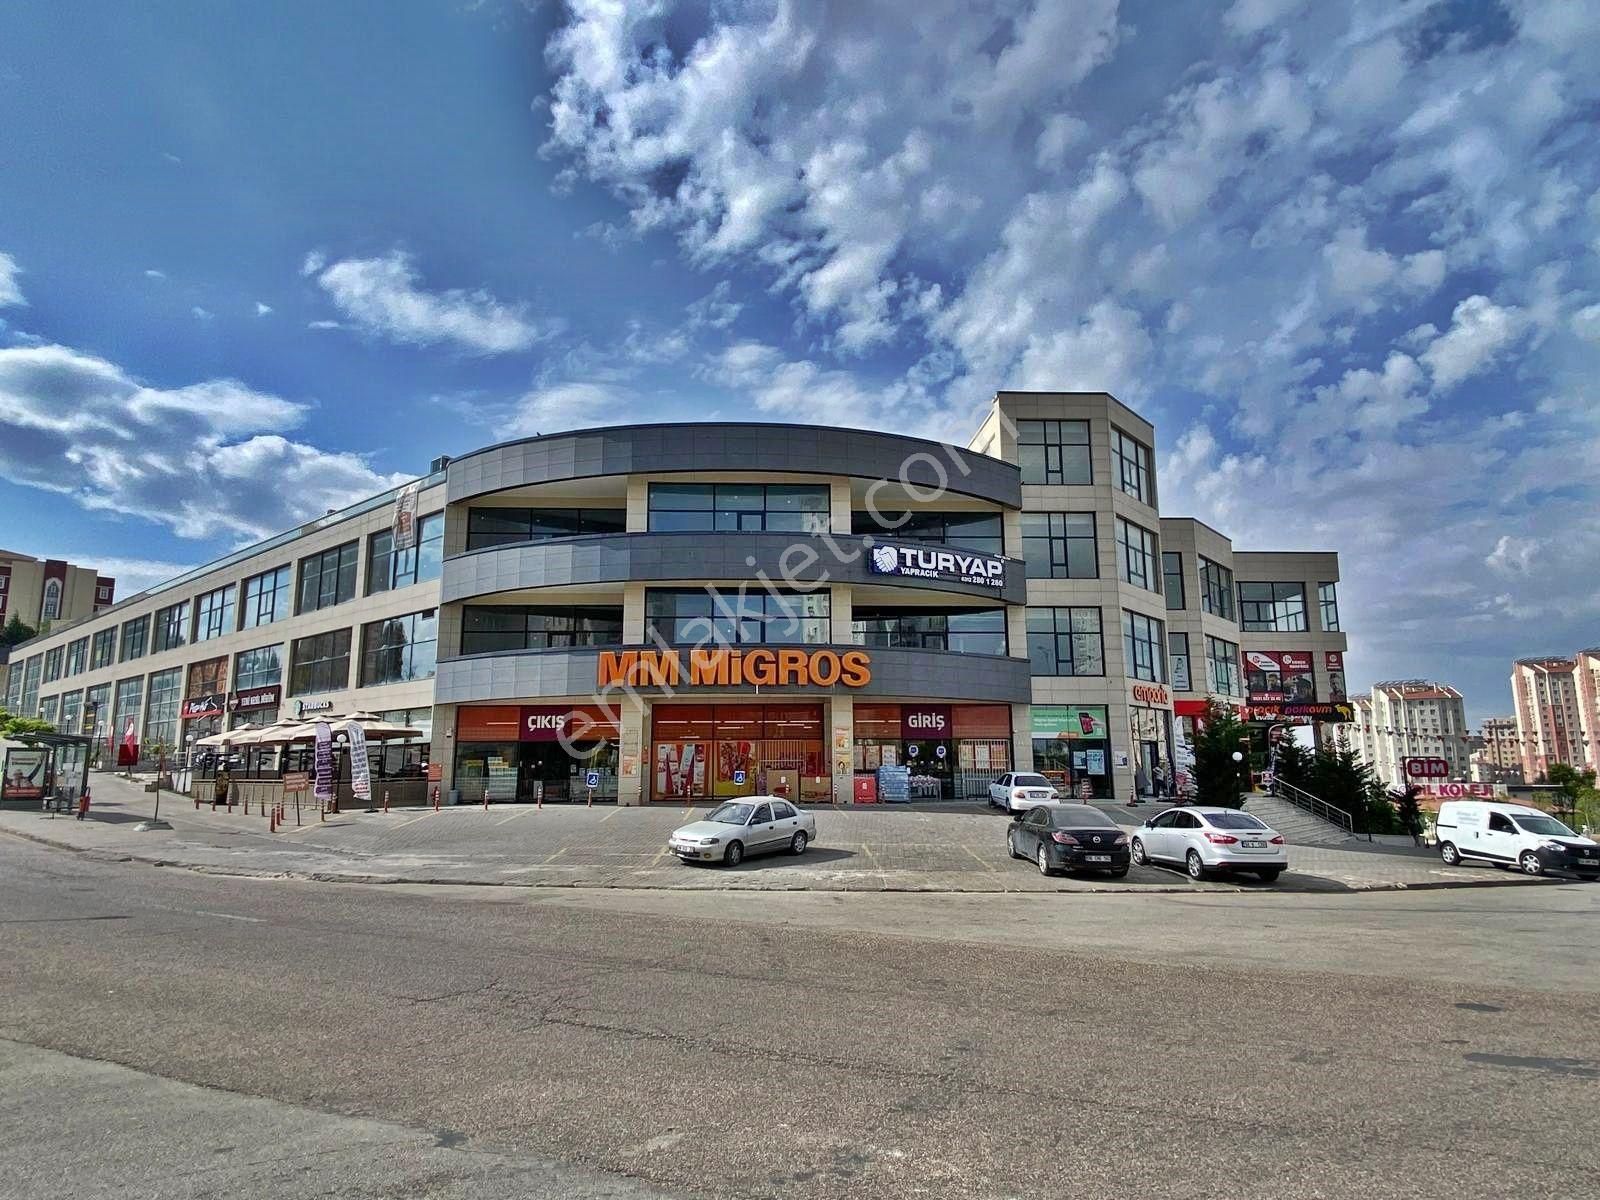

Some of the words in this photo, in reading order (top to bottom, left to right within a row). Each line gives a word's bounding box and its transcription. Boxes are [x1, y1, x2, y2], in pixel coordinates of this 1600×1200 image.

[900, 548, 1003, 577] TURYAP
[900, 567, 939, 578] YAPRACIK
[598, 650, 680, 687] MM
[527, 715, 566, 731] ÇIKIŞ
[908, 712, 945, 730] GİRİŞ
[1412, 760, 1446, 774] BİM
